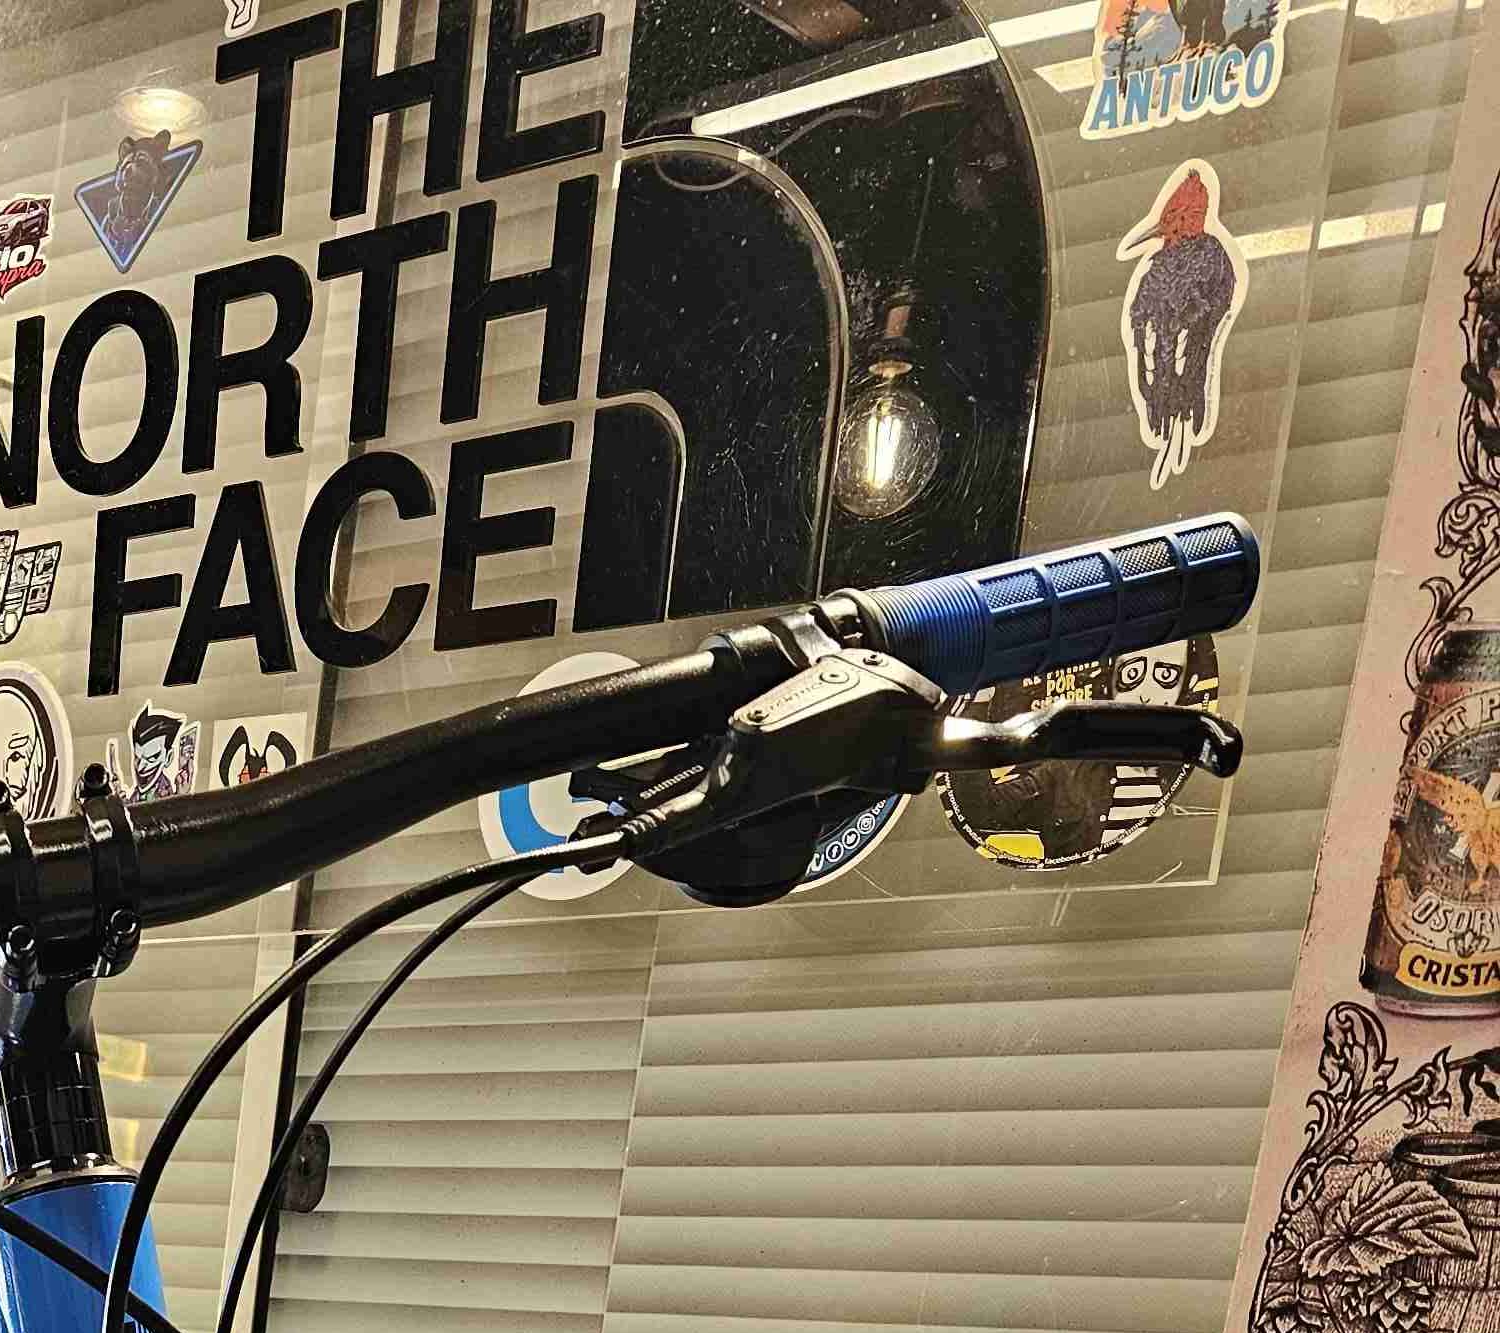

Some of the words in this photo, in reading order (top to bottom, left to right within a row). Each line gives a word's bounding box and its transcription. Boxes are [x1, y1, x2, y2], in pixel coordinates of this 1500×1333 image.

[195, 0, 605, 242] THE
[1088, 41, 1275, 131] ANTUCO
[87, 420, 574, 697] FACE
[639, 764, 705, 800] SHIMANO
[1407, 954, 1500, 988] CRISTA
